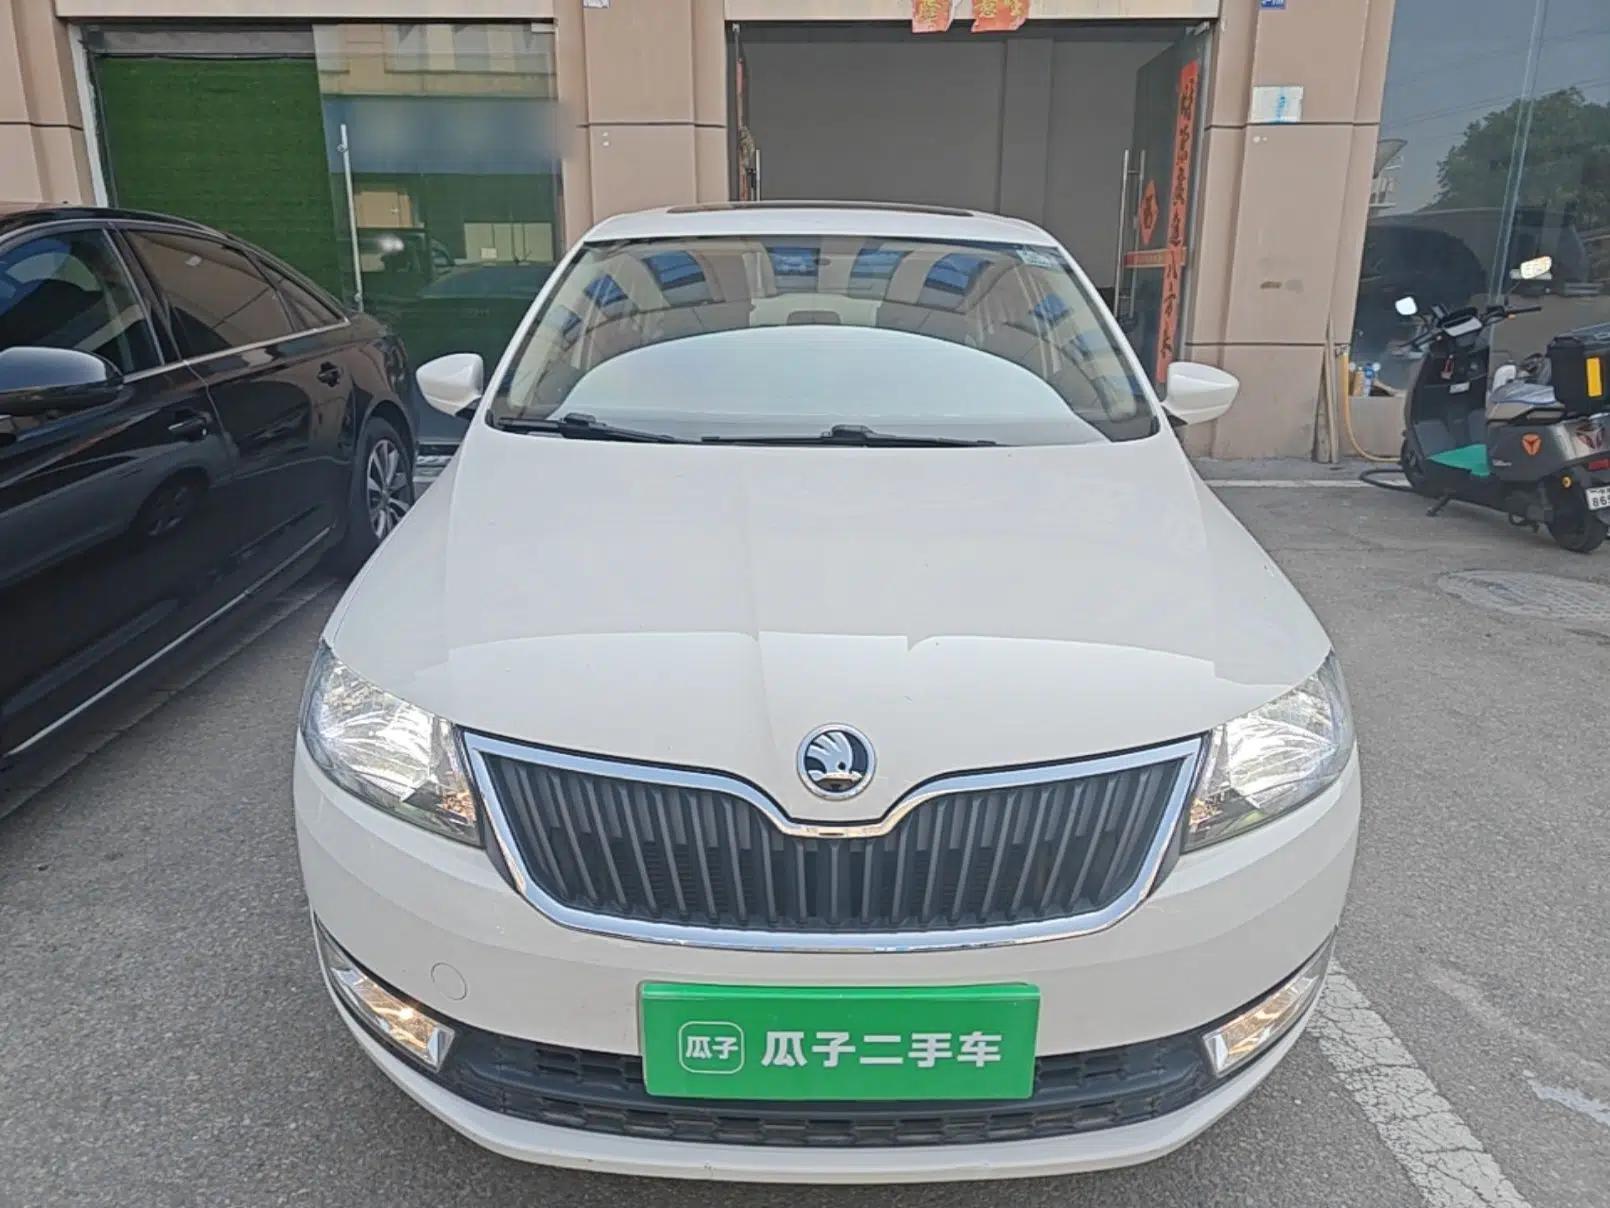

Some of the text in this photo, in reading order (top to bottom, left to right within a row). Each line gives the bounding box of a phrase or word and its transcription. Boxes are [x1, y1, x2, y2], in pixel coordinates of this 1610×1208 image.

[685, 1035, 739, 1061] 瓜子
[761, 1030, 1003, 1068] 瓜子二手车
